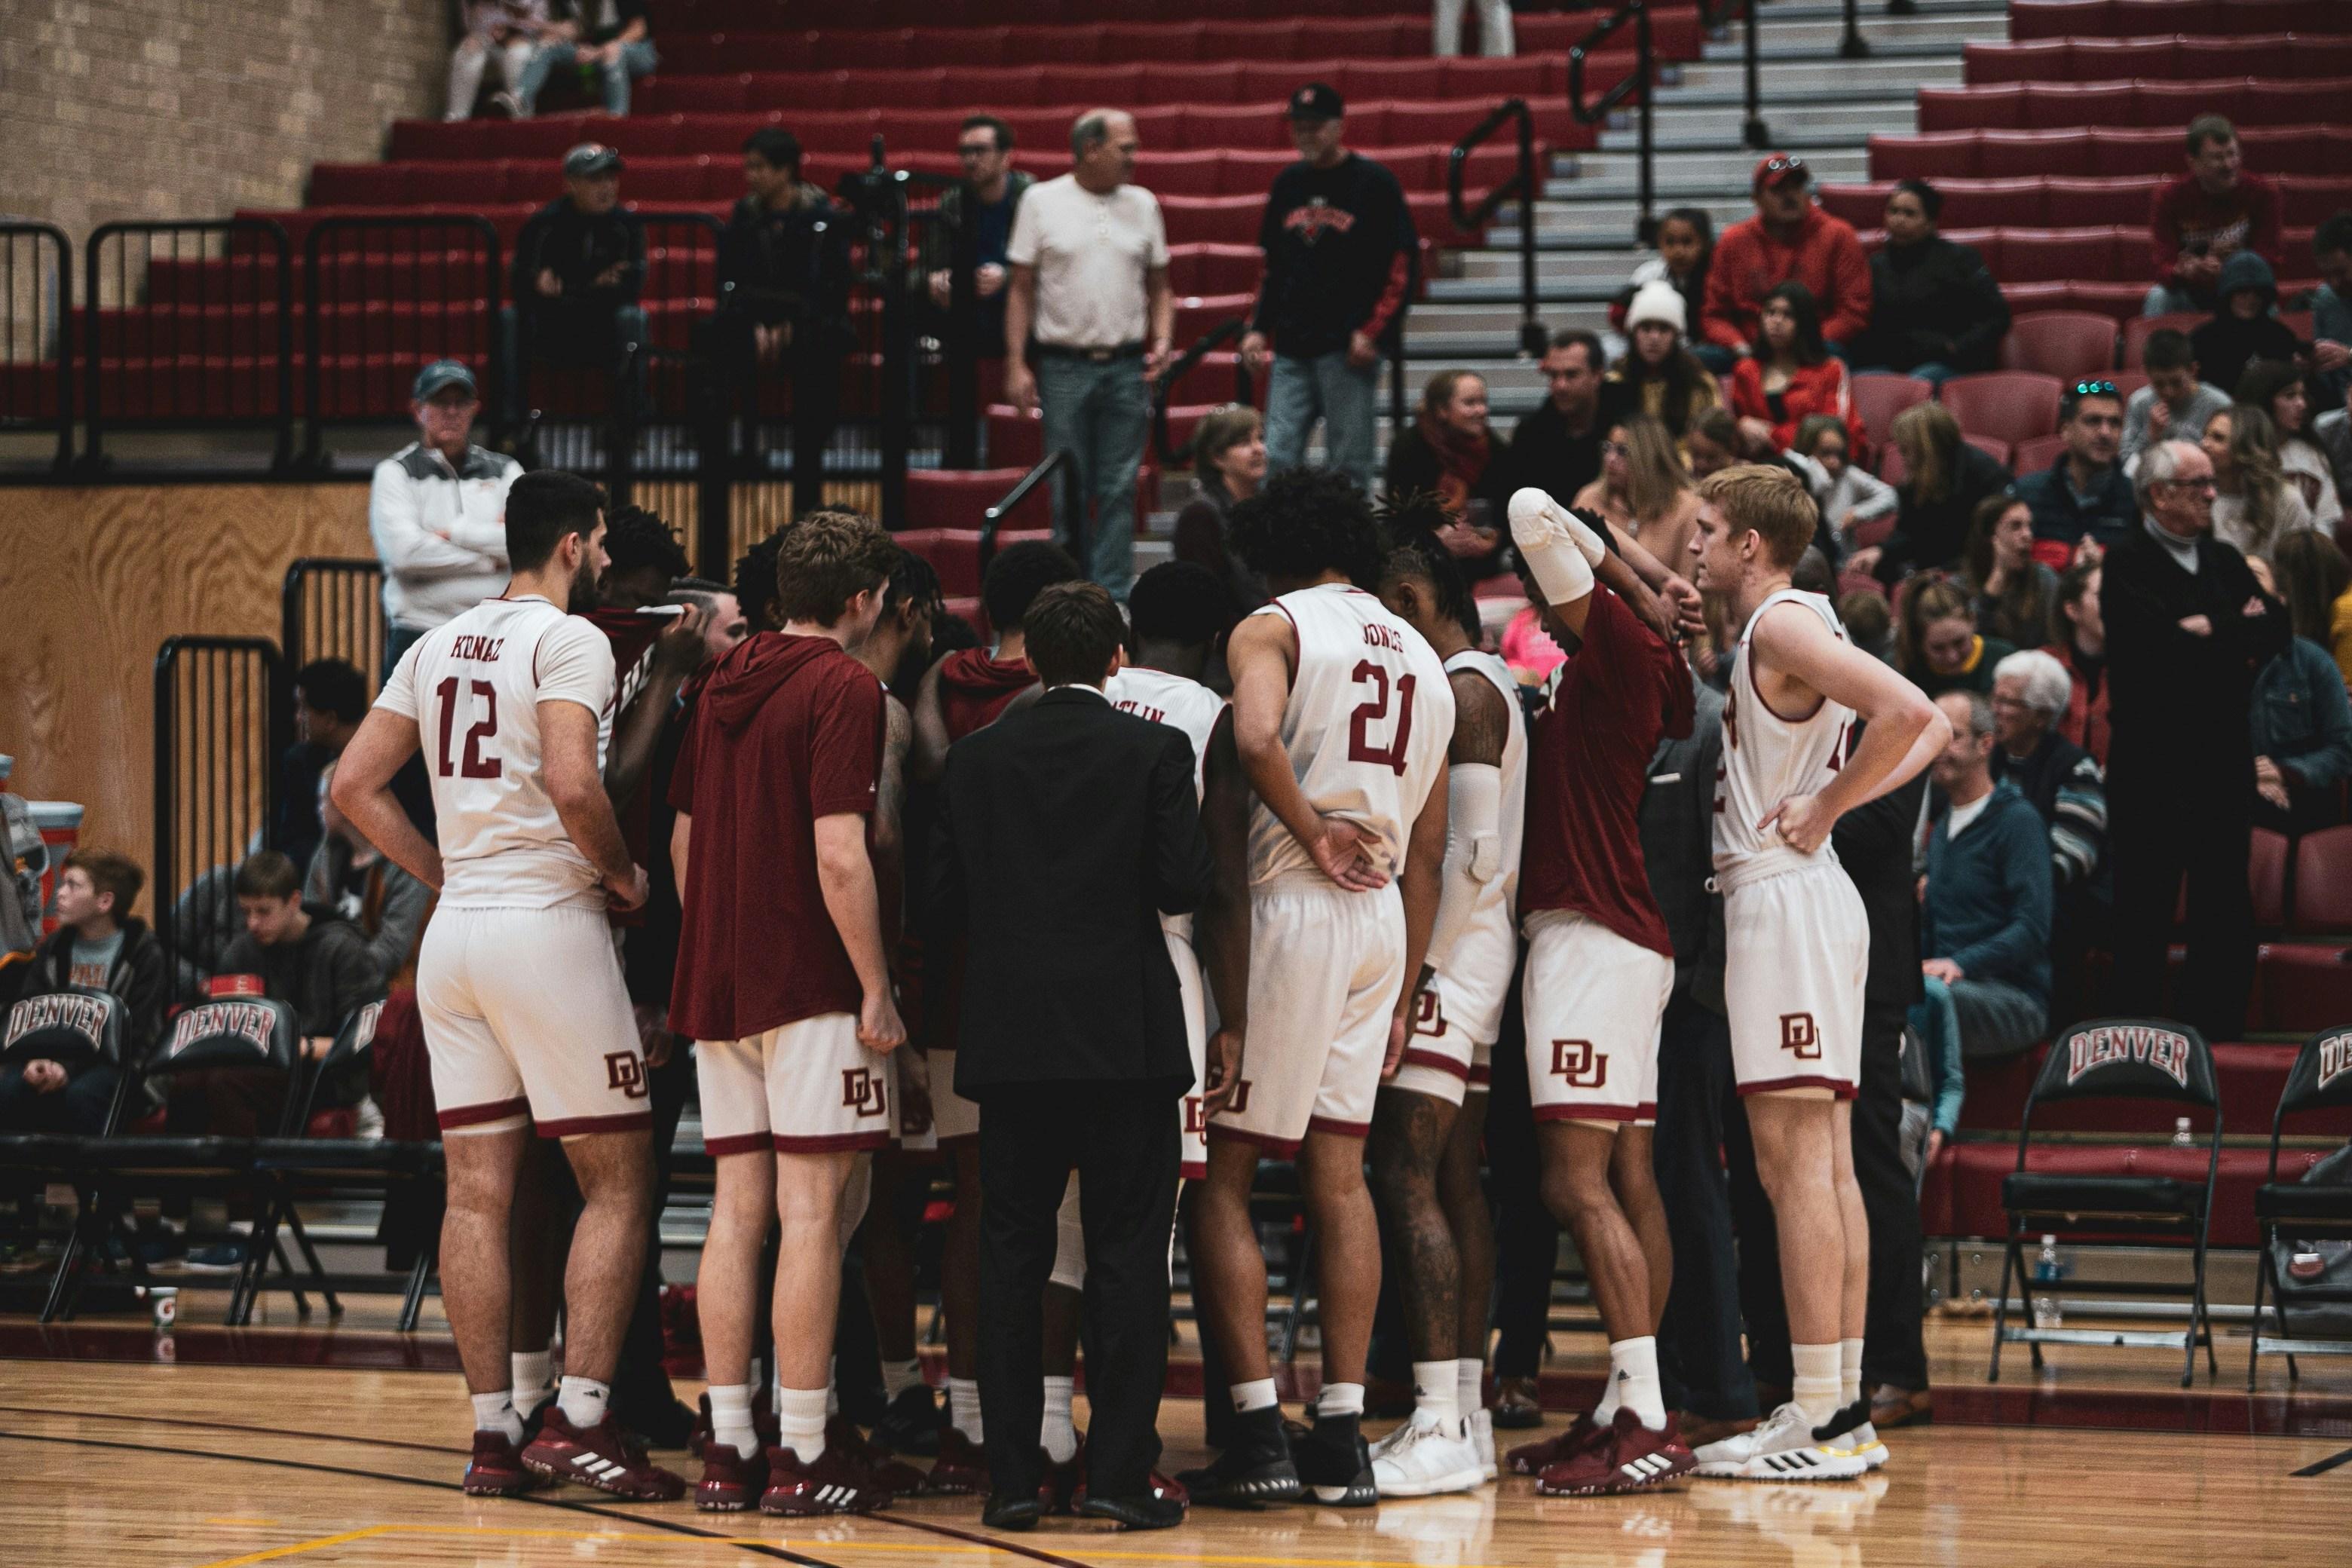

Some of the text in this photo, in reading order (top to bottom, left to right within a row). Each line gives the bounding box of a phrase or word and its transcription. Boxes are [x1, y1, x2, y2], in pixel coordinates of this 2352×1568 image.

[451, 635, 504, 662] KONAZ
[1363, 623, 1404, 654] JONES
[436, 676, 502, 778] 12
[1348, 659, 1416, 777] 21
[4, 994, 109, 1050] DENVER
[170, 1002, 277, 1058] DENVER
[1780, 1012, 1821, 1059] DU
[603, 1050, 649, 1098] DU
[1550, 1039, 1609, 1088] DU
[2067, 1026, 2190, 1089] DENVER
[842, 1067, 886, 1117] DU
